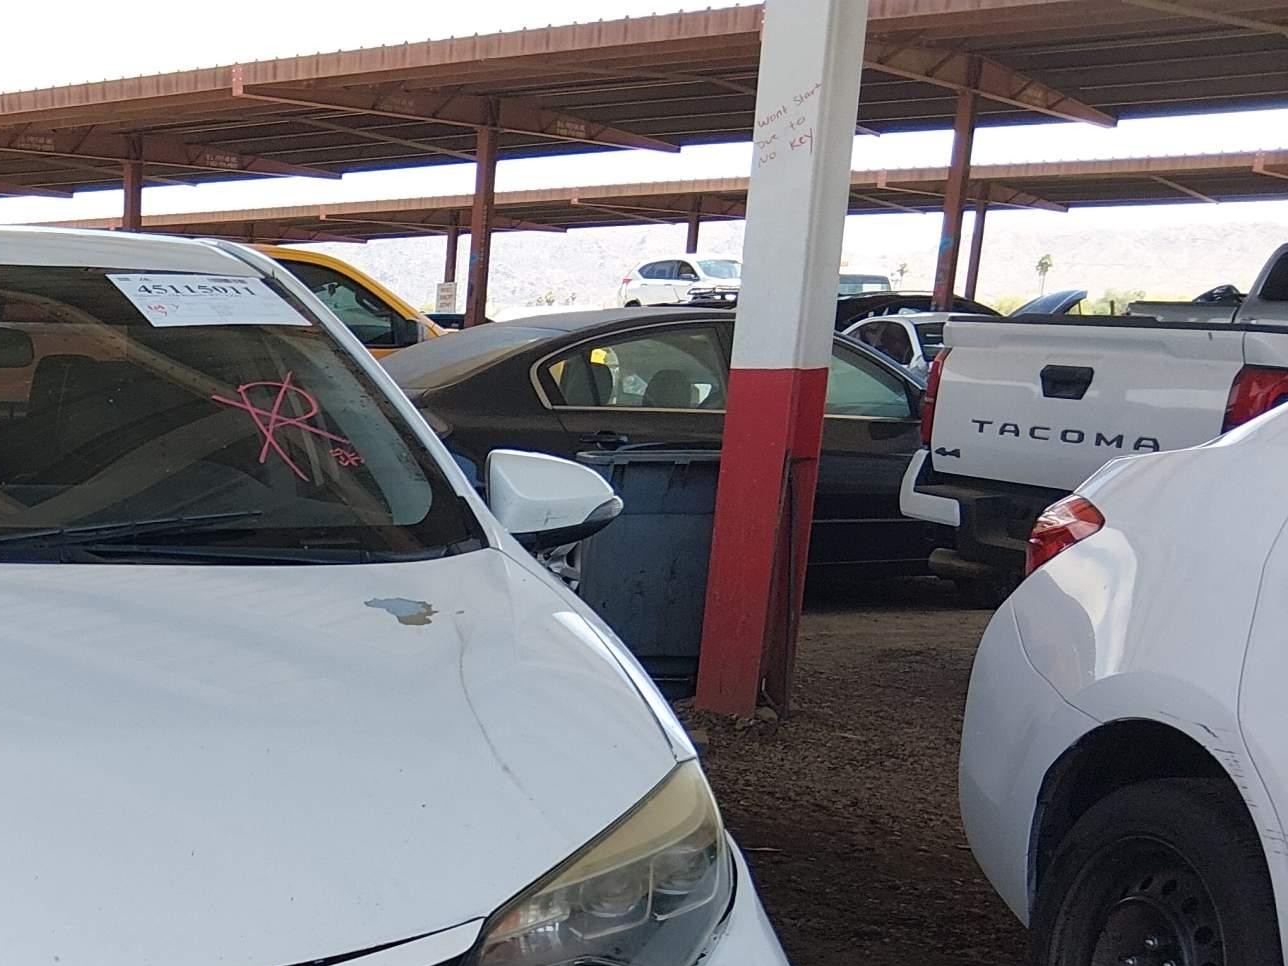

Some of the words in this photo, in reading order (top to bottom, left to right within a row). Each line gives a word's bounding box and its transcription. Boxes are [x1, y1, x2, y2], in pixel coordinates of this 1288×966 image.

[787, 116, 806, 131] to
[137, 283, 256, 297] 45115011
[971, 419, 1161, 452] TACOMA
